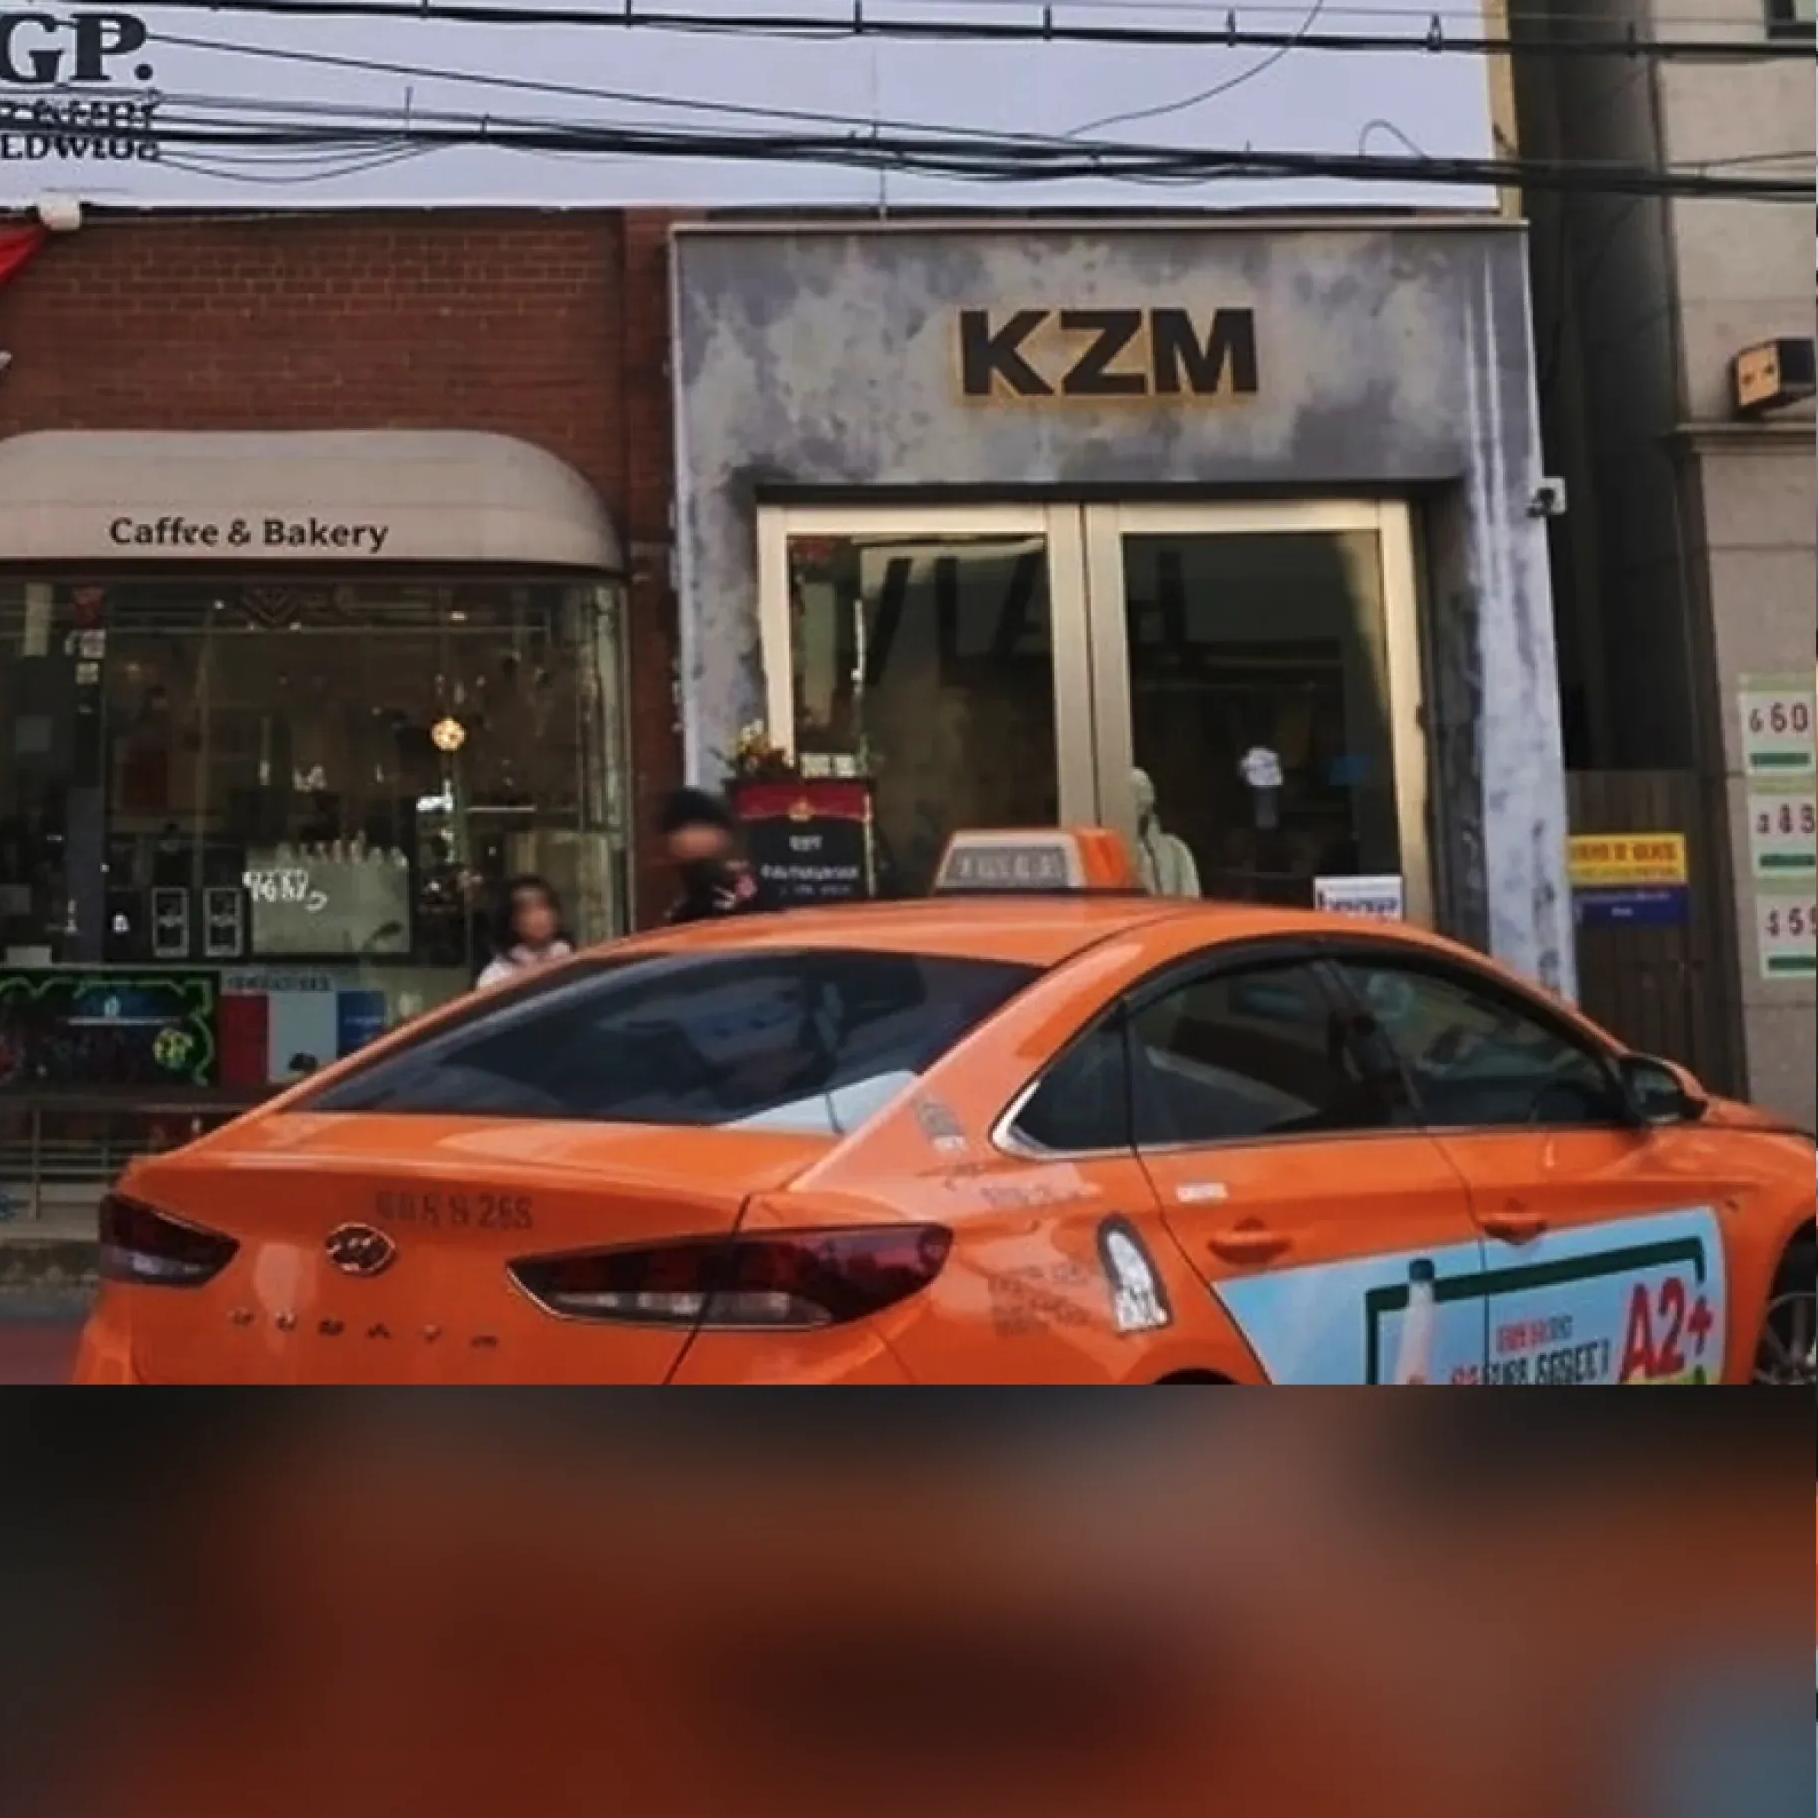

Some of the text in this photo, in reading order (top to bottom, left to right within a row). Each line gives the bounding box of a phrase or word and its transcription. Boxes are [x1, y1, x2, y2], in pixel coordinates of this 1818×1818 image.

[961, 307, 1258, 395] KZM
[227, 519, 252, 546] &
[263, 516, 389, 553] Bakery
